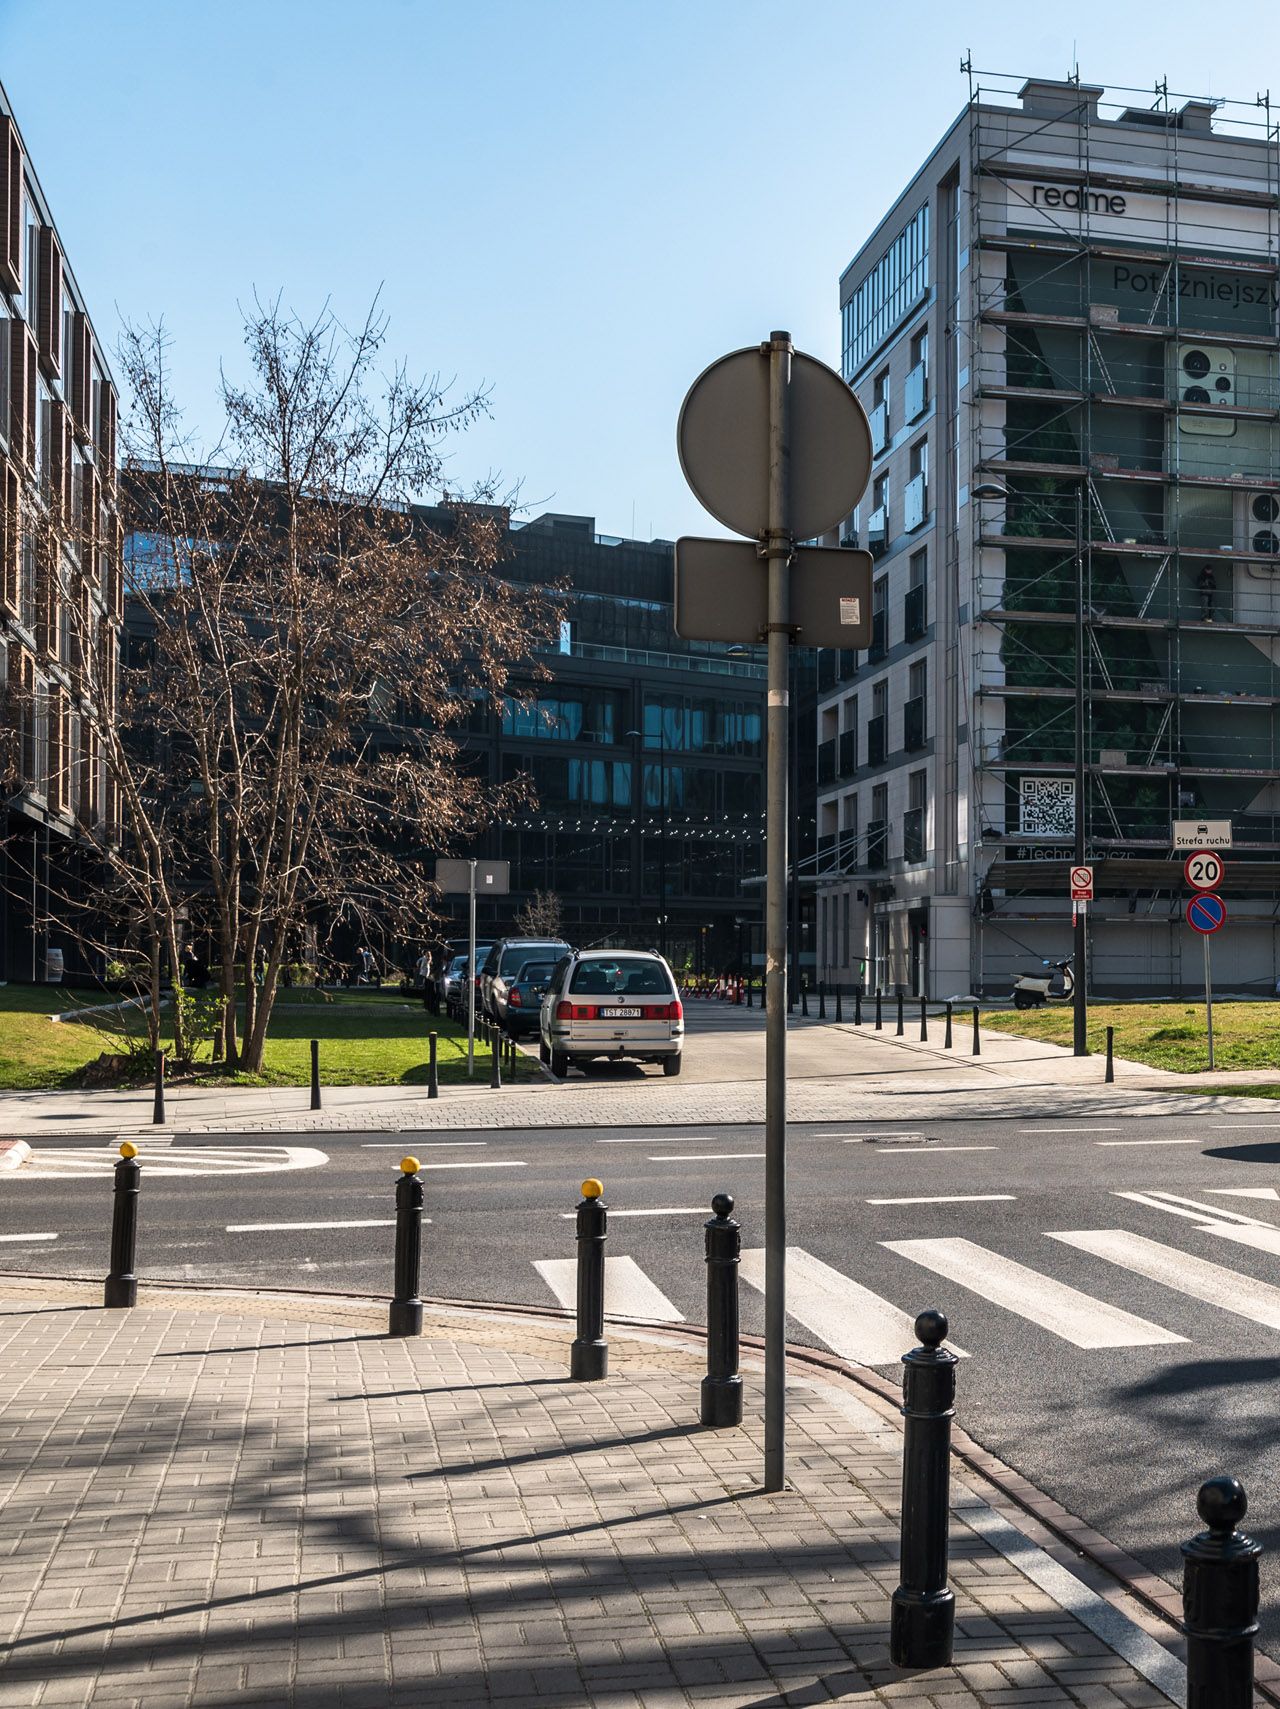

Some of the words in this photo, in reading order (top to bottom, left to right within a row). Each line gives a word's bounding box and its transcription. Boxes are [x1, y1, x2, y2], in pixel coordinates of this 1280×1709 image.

[1032, 184, 1127, 215] realme
[1176, 836, 1203, 845] Strefa
[1206, 836, 1230, 845] ruchu
[1192, 861, 1218, 881] 20
[605, 1008, 617, 1016] TST
